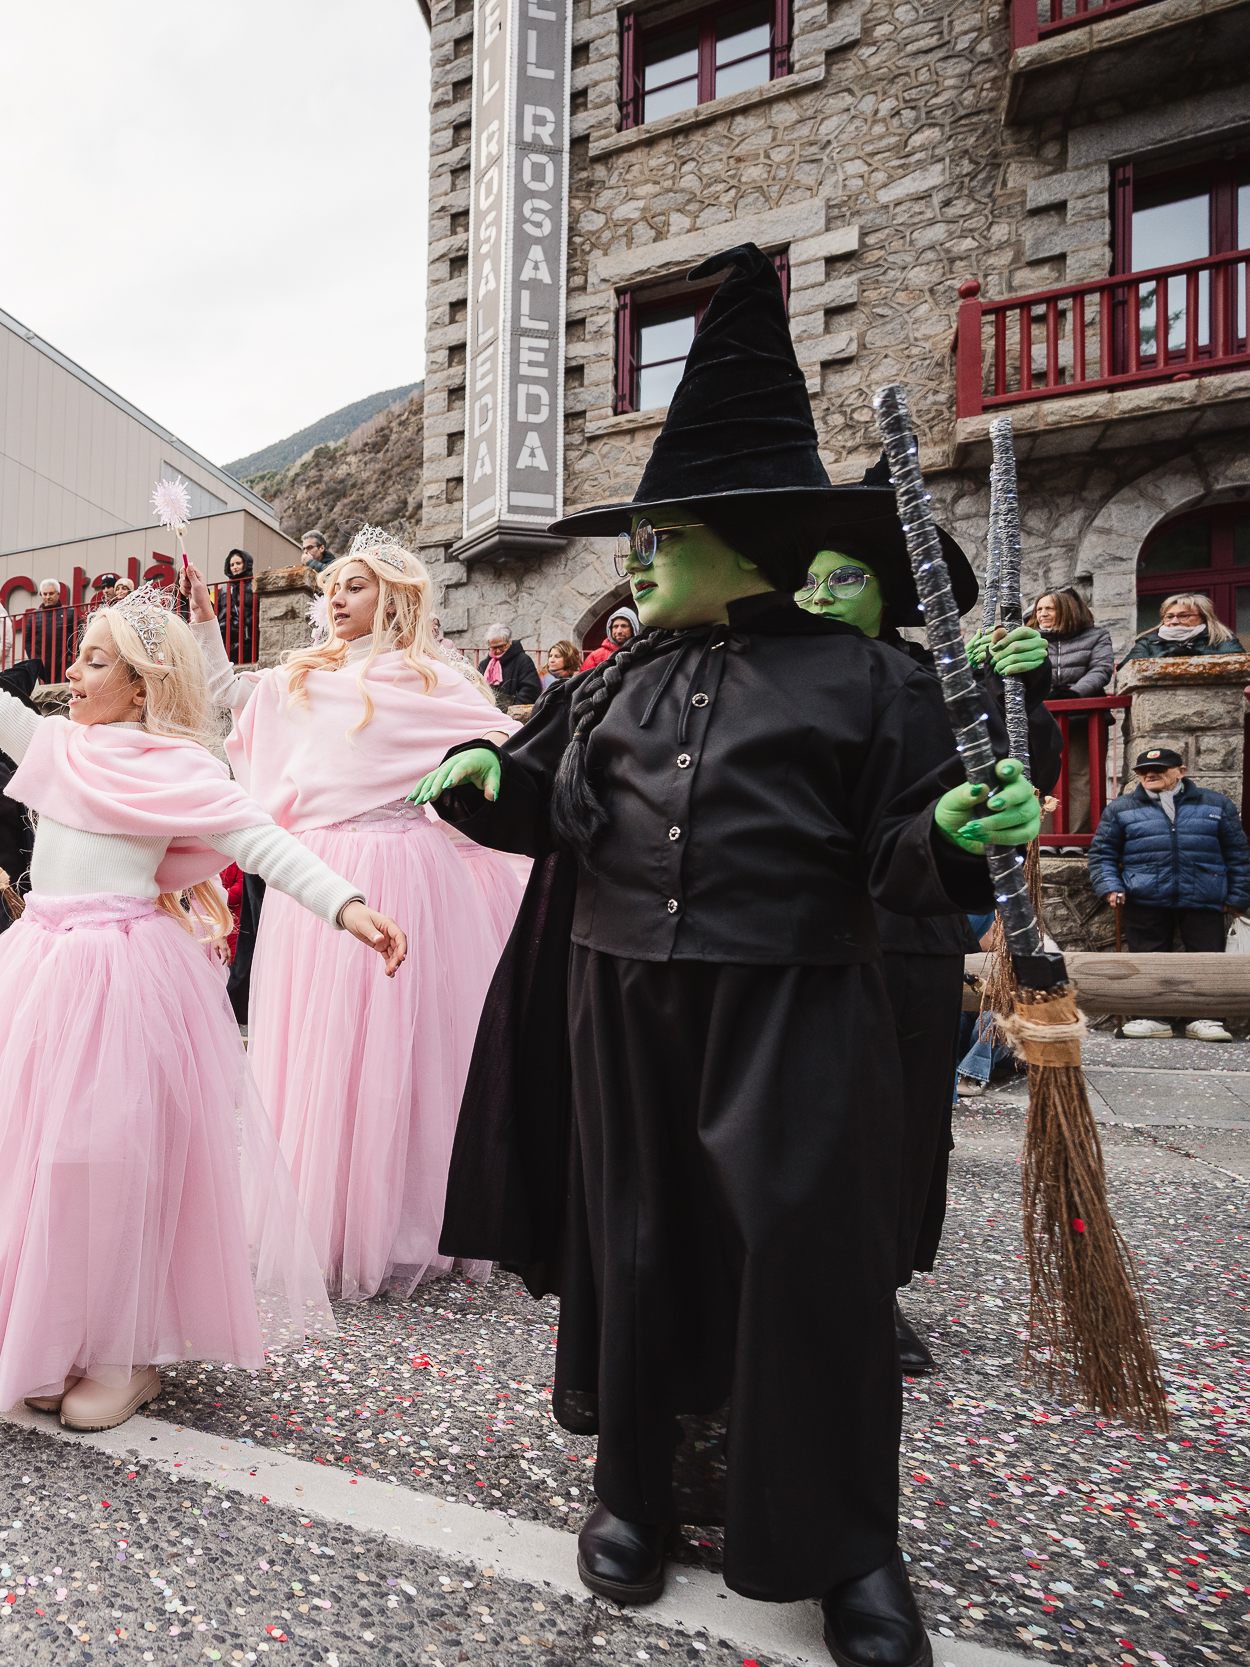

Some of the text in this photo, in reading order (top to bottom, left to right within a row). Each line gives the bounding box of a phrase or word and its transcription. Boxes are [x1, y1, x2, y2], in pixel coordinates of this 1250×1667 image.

[472, 119, 500, 485] ROSALEDA
[515, 103, 556, 472] ROSALEDA
[0, 550, 176, 630] Ctlà
